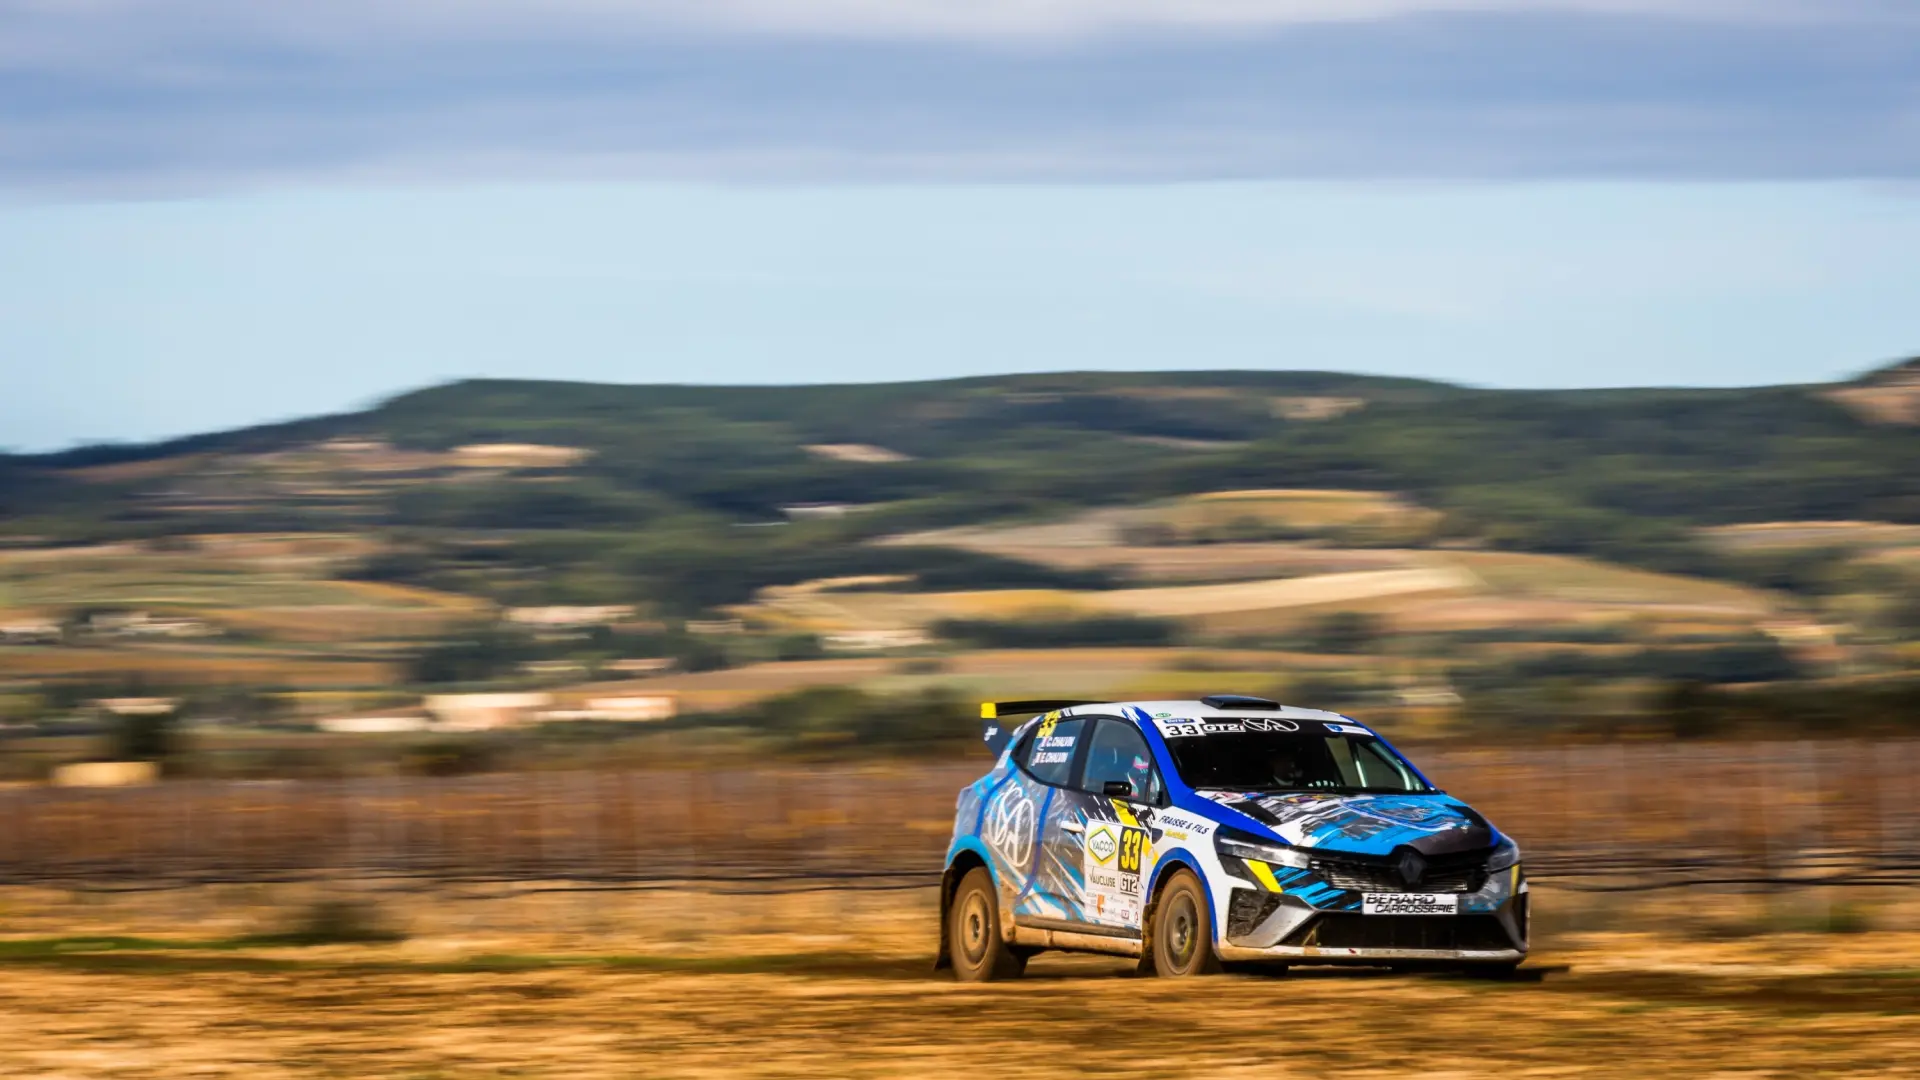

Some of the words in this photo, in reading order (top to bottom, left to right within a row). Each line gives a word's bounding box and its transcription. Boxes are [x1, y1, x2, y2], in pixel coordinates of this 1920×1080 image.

[1166, 724, 1198, 736] 33
[1159, 815, 1188, 828] FRAISSE
[1192, 824, 1210, 834] FILS
[1092, 840, 1113, 853] YACCO
[1121, 829, 1141, 870] 33
[1089, 866, 1115, 887] VAUCLUSE
[1366, 893, 1436, 904] BERARD
[1375, 904, 1456, 913] CARROSSERIE
